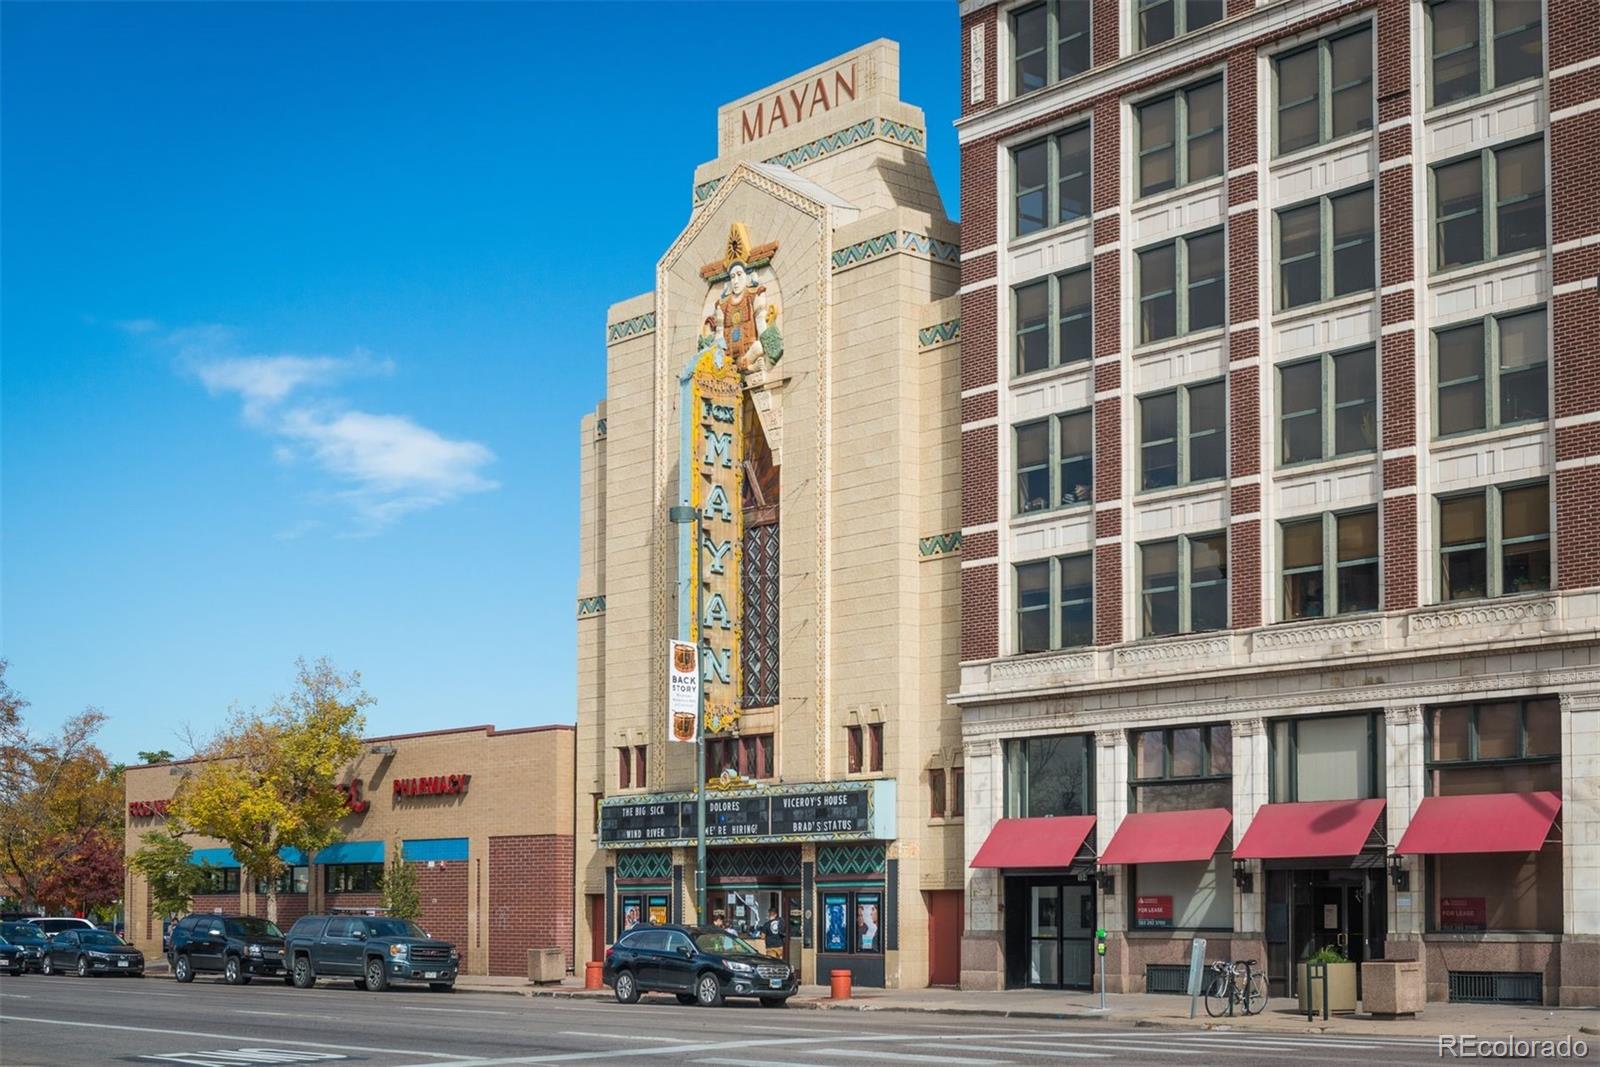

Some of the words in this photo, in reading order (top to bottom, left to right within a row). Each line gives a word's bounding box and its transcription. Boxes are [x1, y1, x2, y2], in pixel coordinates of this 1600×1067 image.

[741, 64, 857, 144] MAYAN
[703, 402, 735, 424] FOX
[703, 430, 732, 684] MAYAN
[672, 676, 696, 685] BACK
[672, 685, 697, 693] STORY
[393, 774, 467, 796] PHARMACY
[709, 801, 740, 812] DOLORES
[783, 796, 821, 808] VICEROY'S
[824, 795, 848, 806] HOUSE
[622, 807, 634, 817] THE
[635, 806, 646, 816] BIG
[650, 805, 665, 815] SICK
[732, 824, 758, 834] HIRING!
[793, 821, 821, 832] BRAD'S
[823, 820, 852, 831] STATUS
[626, 829, 642, 839] WIND
[646, 828, 665, 838] RIVER
